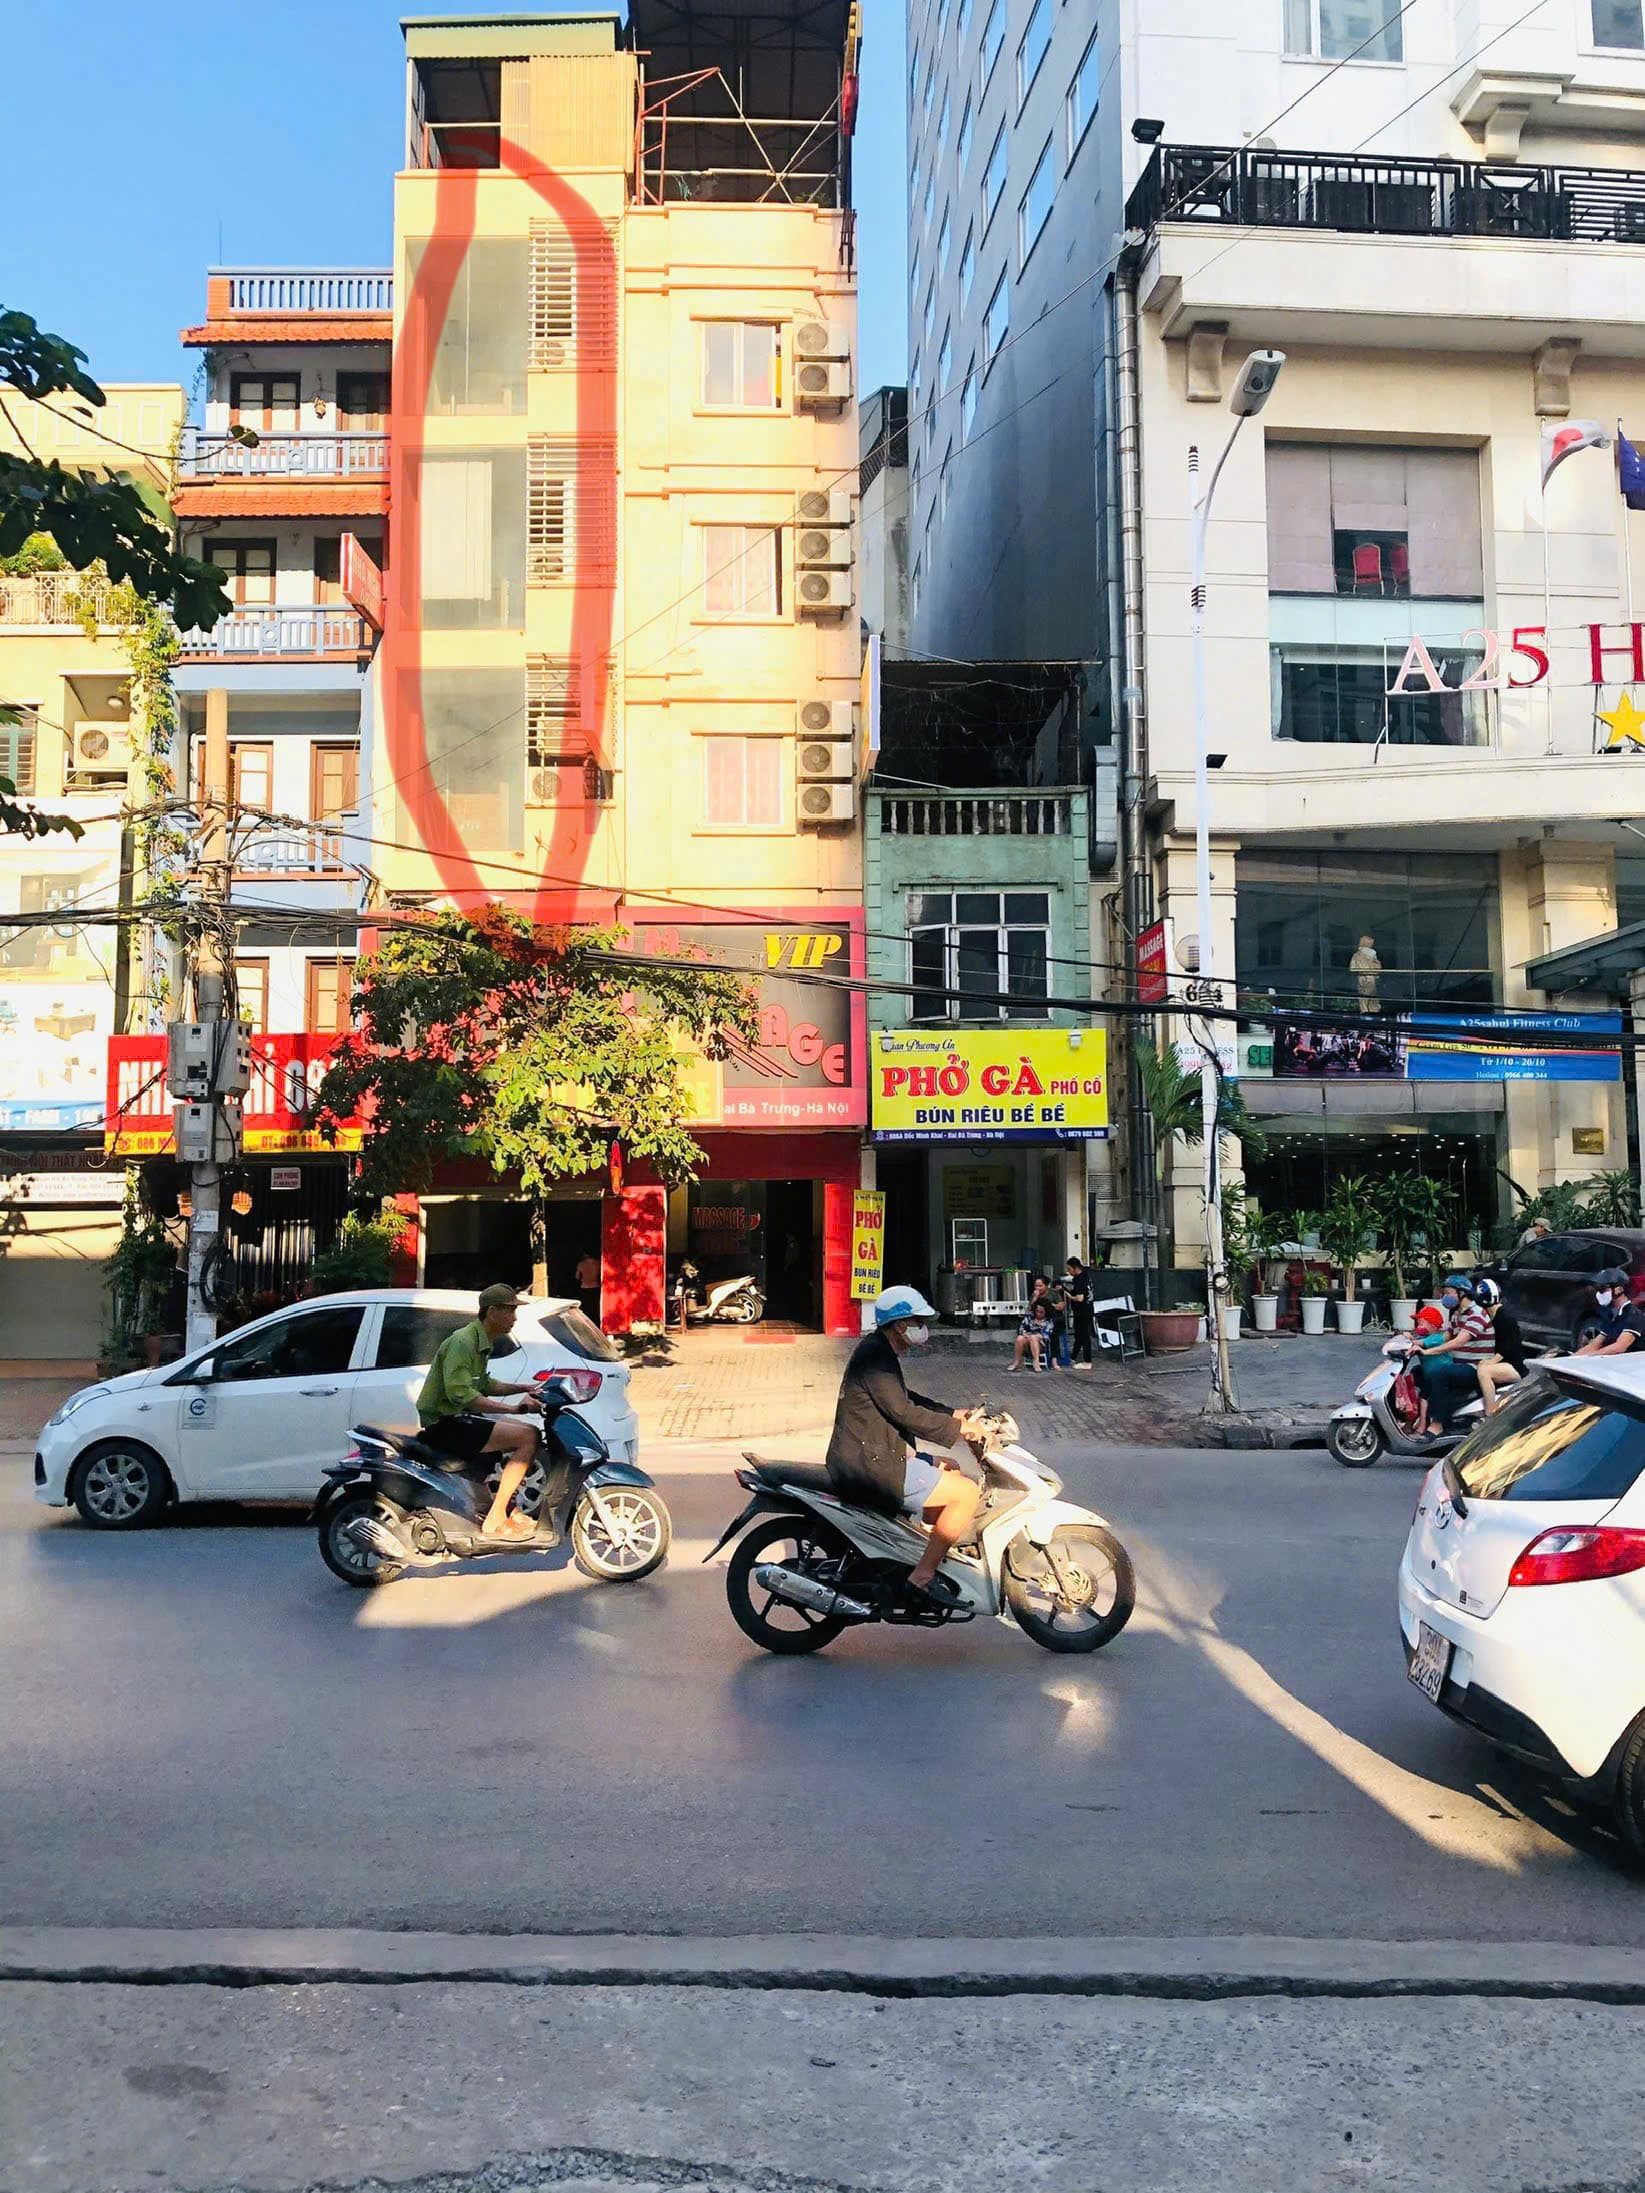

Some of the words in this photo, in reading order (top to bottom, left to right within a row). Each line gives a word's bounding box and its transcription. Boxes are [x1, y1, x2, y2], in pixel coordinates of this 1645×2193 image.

[1385, 625, 1549, 693] A25
[1587, 621, 1645, 685] H
[763, 934, 843, 969] VIP
[1512, 1018, 1551, 1028] Fitness
[1554, 1017, 1580, 1028] Club
[1496, 1057, 1514, 1066] 1/10
[1521, 1057, 1546, 1067] 20/10
[881, 1054, 969, 1097] PHỞ
[981, 1056, 1045, 1097] GÀ
[1051, 1075, 1078, 1095] PHỐ
[827, 1102, 849, 1116] Nội
[916, 1105, 954, 1124] BÚN
[961, 1105, 1004, 1123] RIÊU
[1011, 1103, 1035, 1122] BỀ
[1042, 1103, 1064, 1122] BỀ
[855, 1205, 882, 1229] PHỞ
[858, 1238, 878, 1261] GÀ
